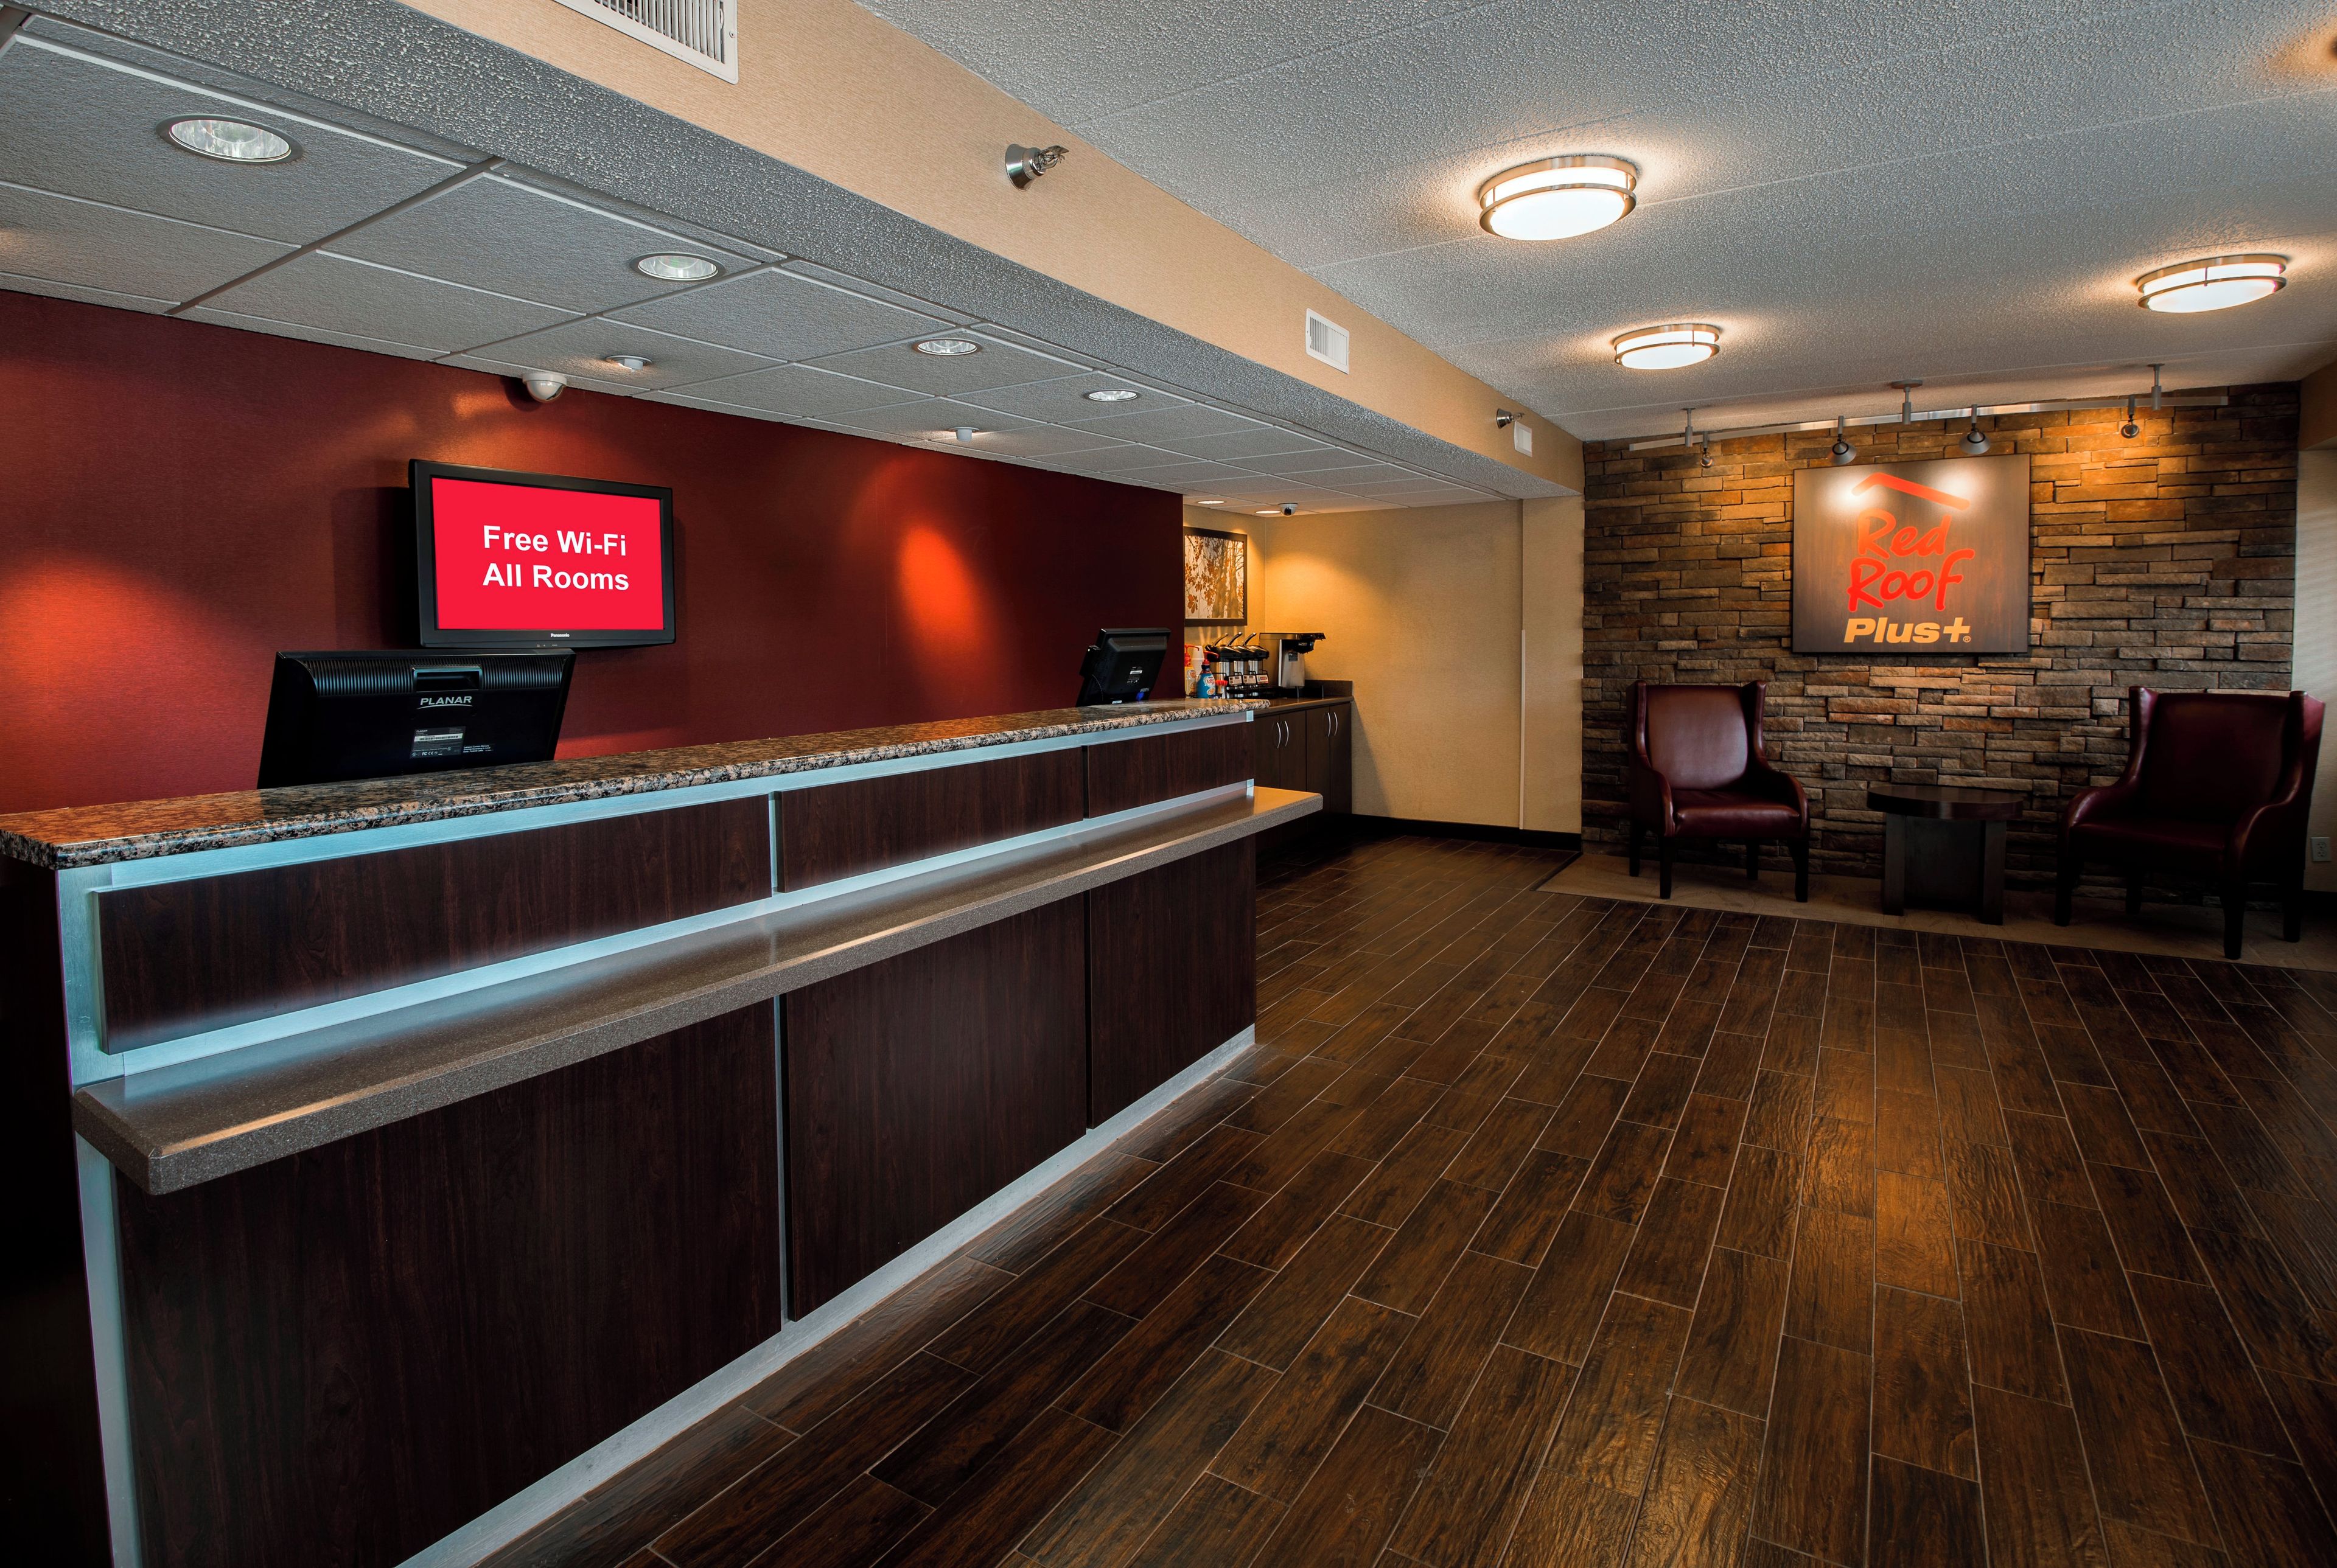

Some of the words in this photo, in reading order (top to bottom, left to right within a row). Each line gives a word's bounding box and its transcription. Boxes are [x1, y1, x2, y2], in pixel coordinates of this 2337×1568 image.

[483, 525, 548, 552] Free
[557, 530, 626, 556] Wi-Fi
[1858, 509, 1951, 559] Red
[482, 563, 522, 587] All
[533, 565, 629, 591] Rooms
[1846, 548, 1975, 613] Roof
[420, 695, 472, 705] PLANAR
